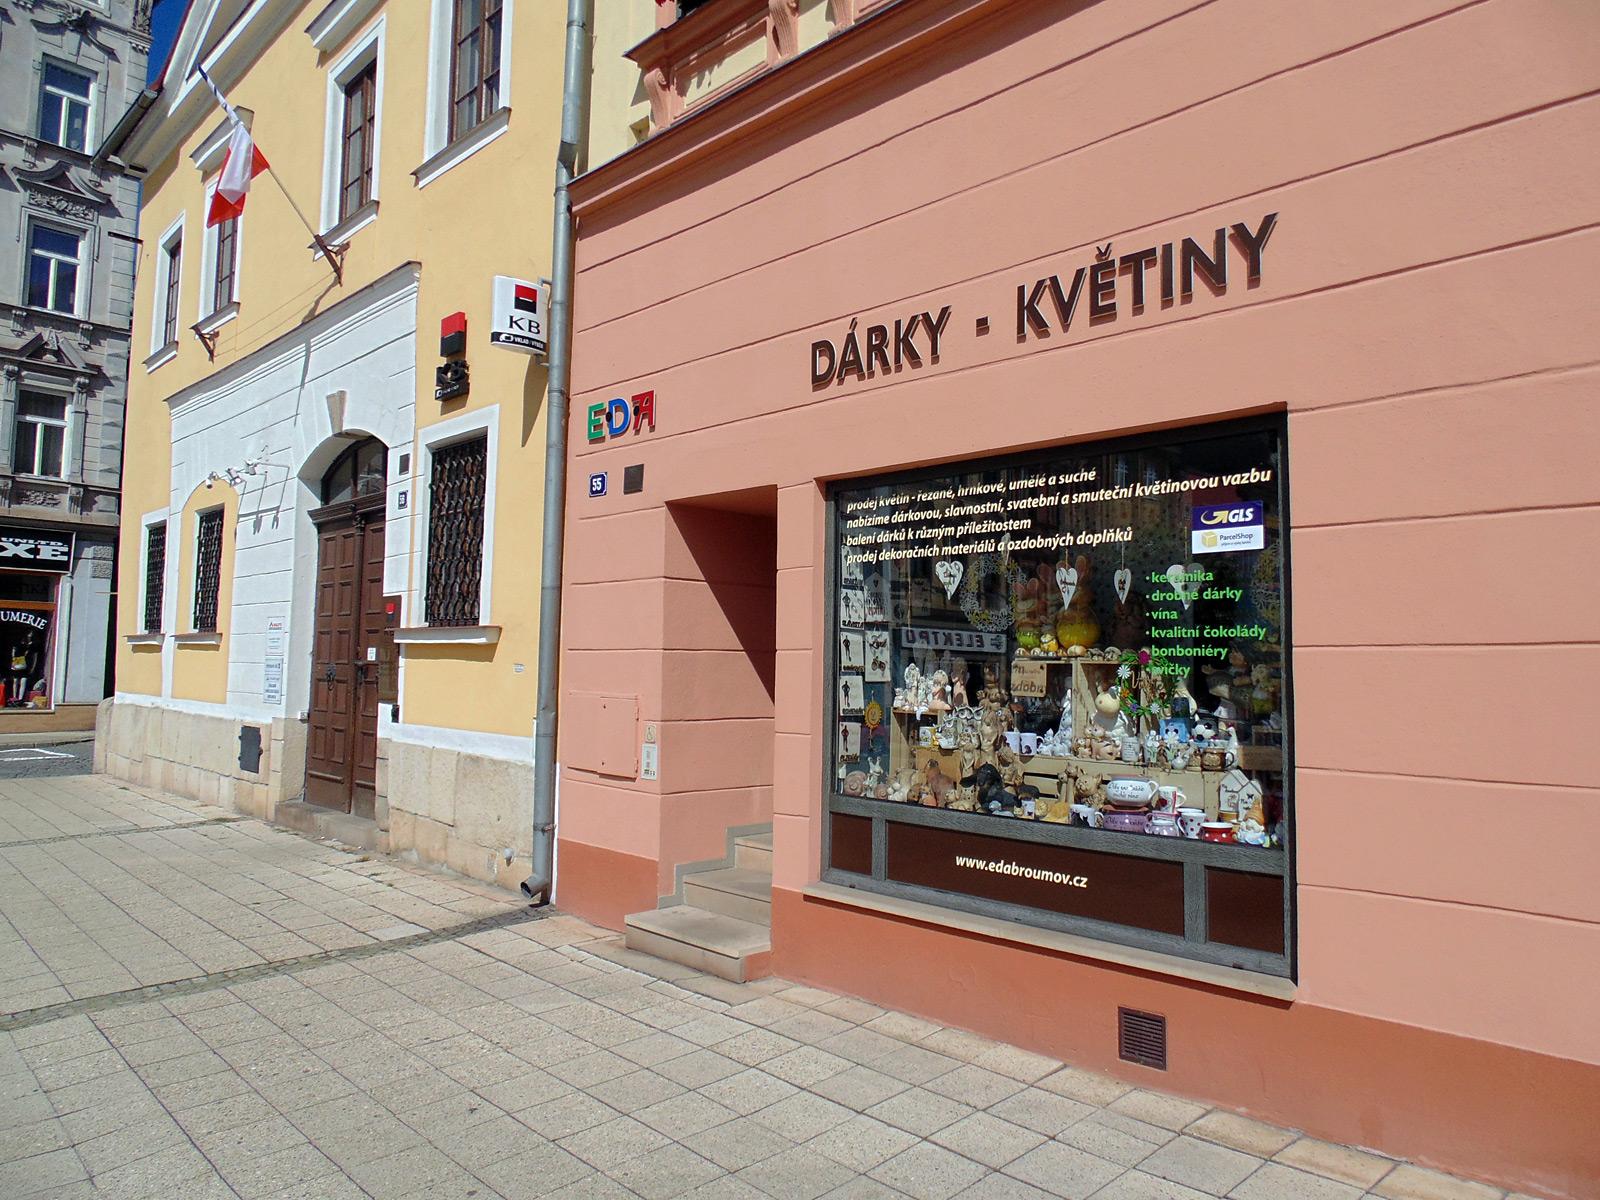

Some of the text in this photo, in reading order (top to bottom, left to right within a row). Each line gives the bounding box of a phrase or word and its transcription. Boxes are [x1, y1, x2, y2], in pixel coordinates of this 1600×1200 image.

[811, 211, 1279, 388] DÁRKY KVĚTINY
[508, 315, 541, 335] KB
[592, 477, 602, 491] 55
[847, 495, 878, 513] prodej
[879, 492, 910, 508] květin
[917, 487, 955, 502] řezané,
[958, 481, 1007, 497] hrnkové,
[1009, 473, 1046, 491] umělé
[1048, 477, 1057, 486] a
[1059, 467, 1097, 483] suché
[847, 468, 1272, 529] nabízíme dárkovou, slavnostní, svatební a smuteční květinovou vazbu
[1228, 507, 1255, 523] GLS
[846, 518, 1031, 546] balení dárků k různým příležitostem
[1219, 532, 1254, 542] ParcelShop
[847, 526, 1133, 566] prodej dekoračních materiálů a ozdobných doplňků
[1151, 586, 1243, 602] drobné dárky
[1151, 607, 1178, 620] vína
[1151, 624, 1267, 640] kvalitní čokolády
[1151, 644, 1228, 660] bonboniéry
[1151, 662, 1191, 679] víčky
[955, 855, 1089, 889] www.edabroumov.cz
